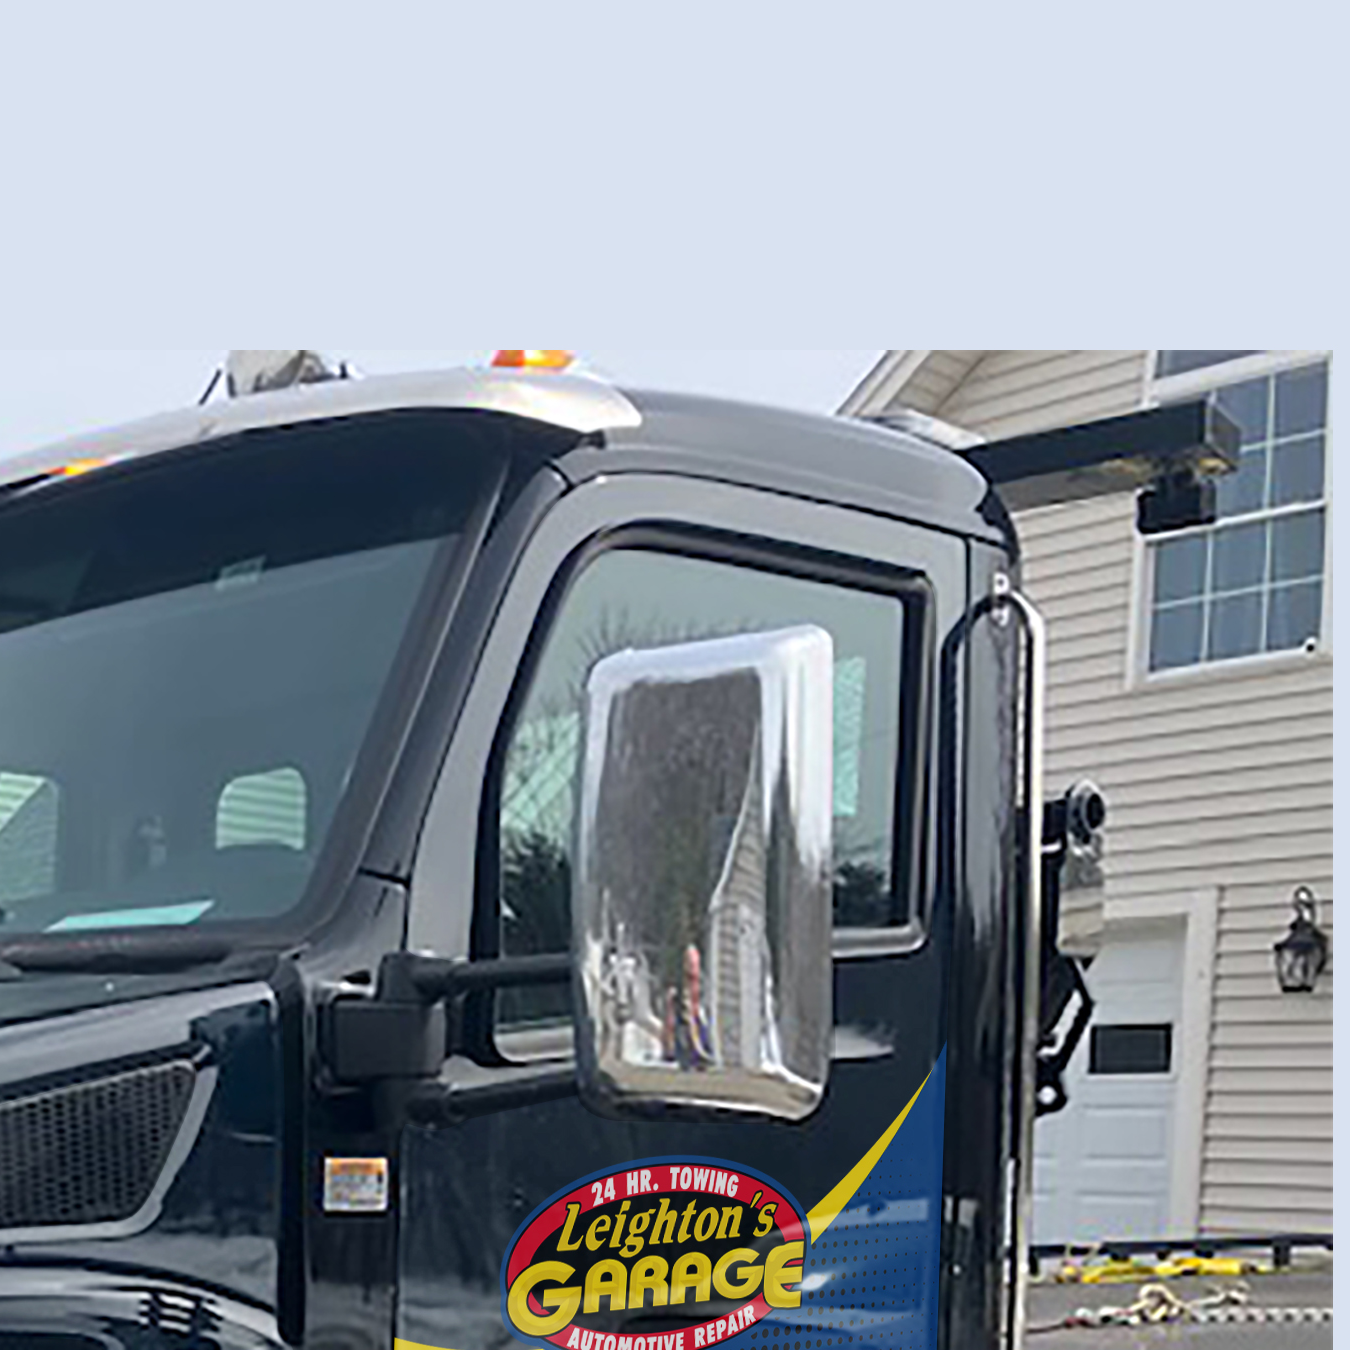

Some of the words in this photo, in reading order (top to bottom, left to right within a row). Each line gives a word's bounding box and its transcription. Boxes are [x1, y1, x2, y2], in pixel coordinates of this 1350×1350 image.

[591, 1177, 616, 1207] 24
[626, 1169, 659, 1196] HR.
[670, 1166, 739, 1197] TOWING
[556, 1190, 777, 1258] Leighton's
[507, 1240, 805, 1336] GARAGE
[694, 1304, 756, 1348] REPAIR
